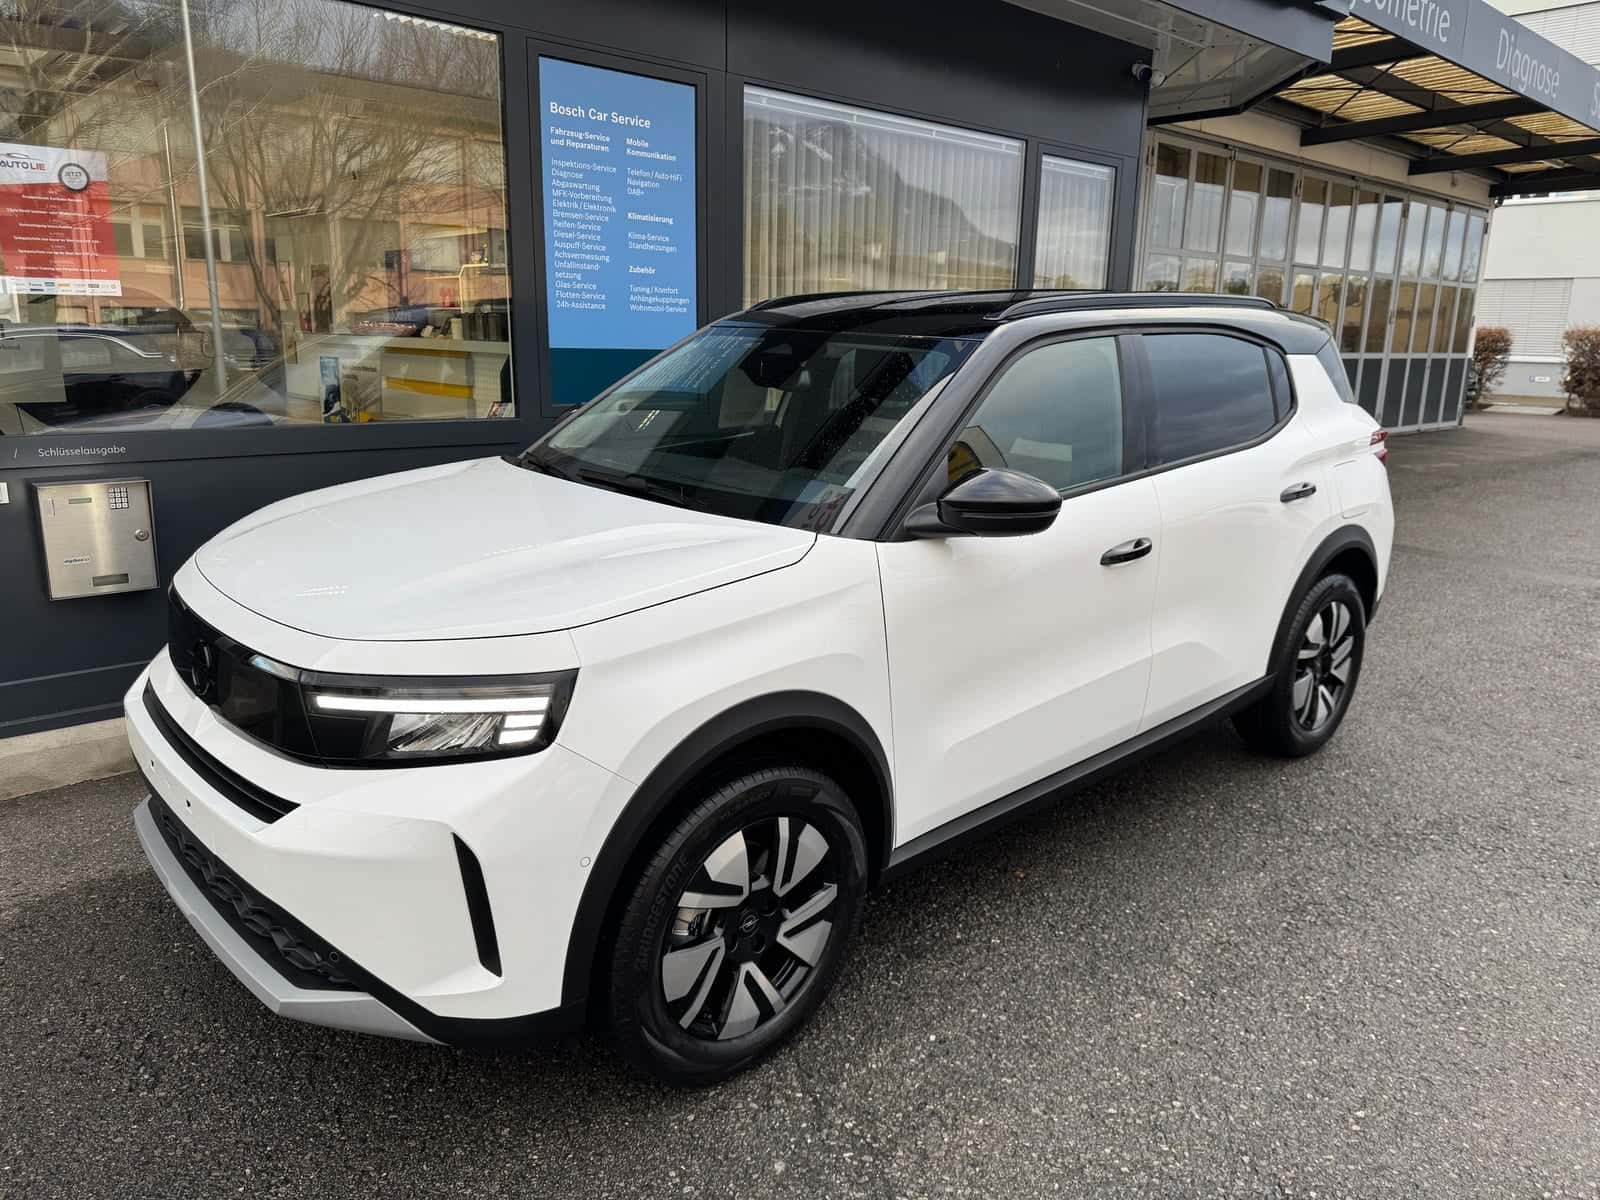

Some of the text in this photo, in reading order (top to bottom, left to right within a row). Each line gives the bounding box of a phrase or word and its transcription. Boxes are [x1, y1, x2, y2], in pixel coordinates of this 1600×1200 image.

[1496, 29, 1560, 98] Diagnose
[549, 101, 651, 129] Bosch Car Service
[550, 126, 610, 142] Fahrzeug-Service
[550, 138, 610, 152] und Reparaturen
[626, 137, 649, 148] Mobile
[626, 147, 677, 161] Kommunikation
[551, 157, 617, 174] Inspektions-Service
[551, 167, 584, 179] Diagnose
[627, 167, 651, 178] Telefon
[552, 178, 601, 193] Abgaswartung
[626, 176, 660, 189] Navigation
[552, 199, 579, 209] Elektrik
[583, 202, 617, 213] Elektronik
[553, 208, 609, 222] Bremsen-Service
[627, 211, 674, 225] Klimatisierung
[553, 219, 601, 232] Reifen-Service
[553, 229, 601, 242] Diesel-Service
[628, 231, 670, 242] Klima-Service
[554, 240, 607, 252] Auspuff-Service
[554, 250, 610, 263] Achsvermessung
[628, 264, 656, 275] Zubehör
[555, 280, 597, 291] Glas-Service
[555, 290, 606, 302] Flotten-Service
[38, 444, 127, 457] Schlüsselausgabe
